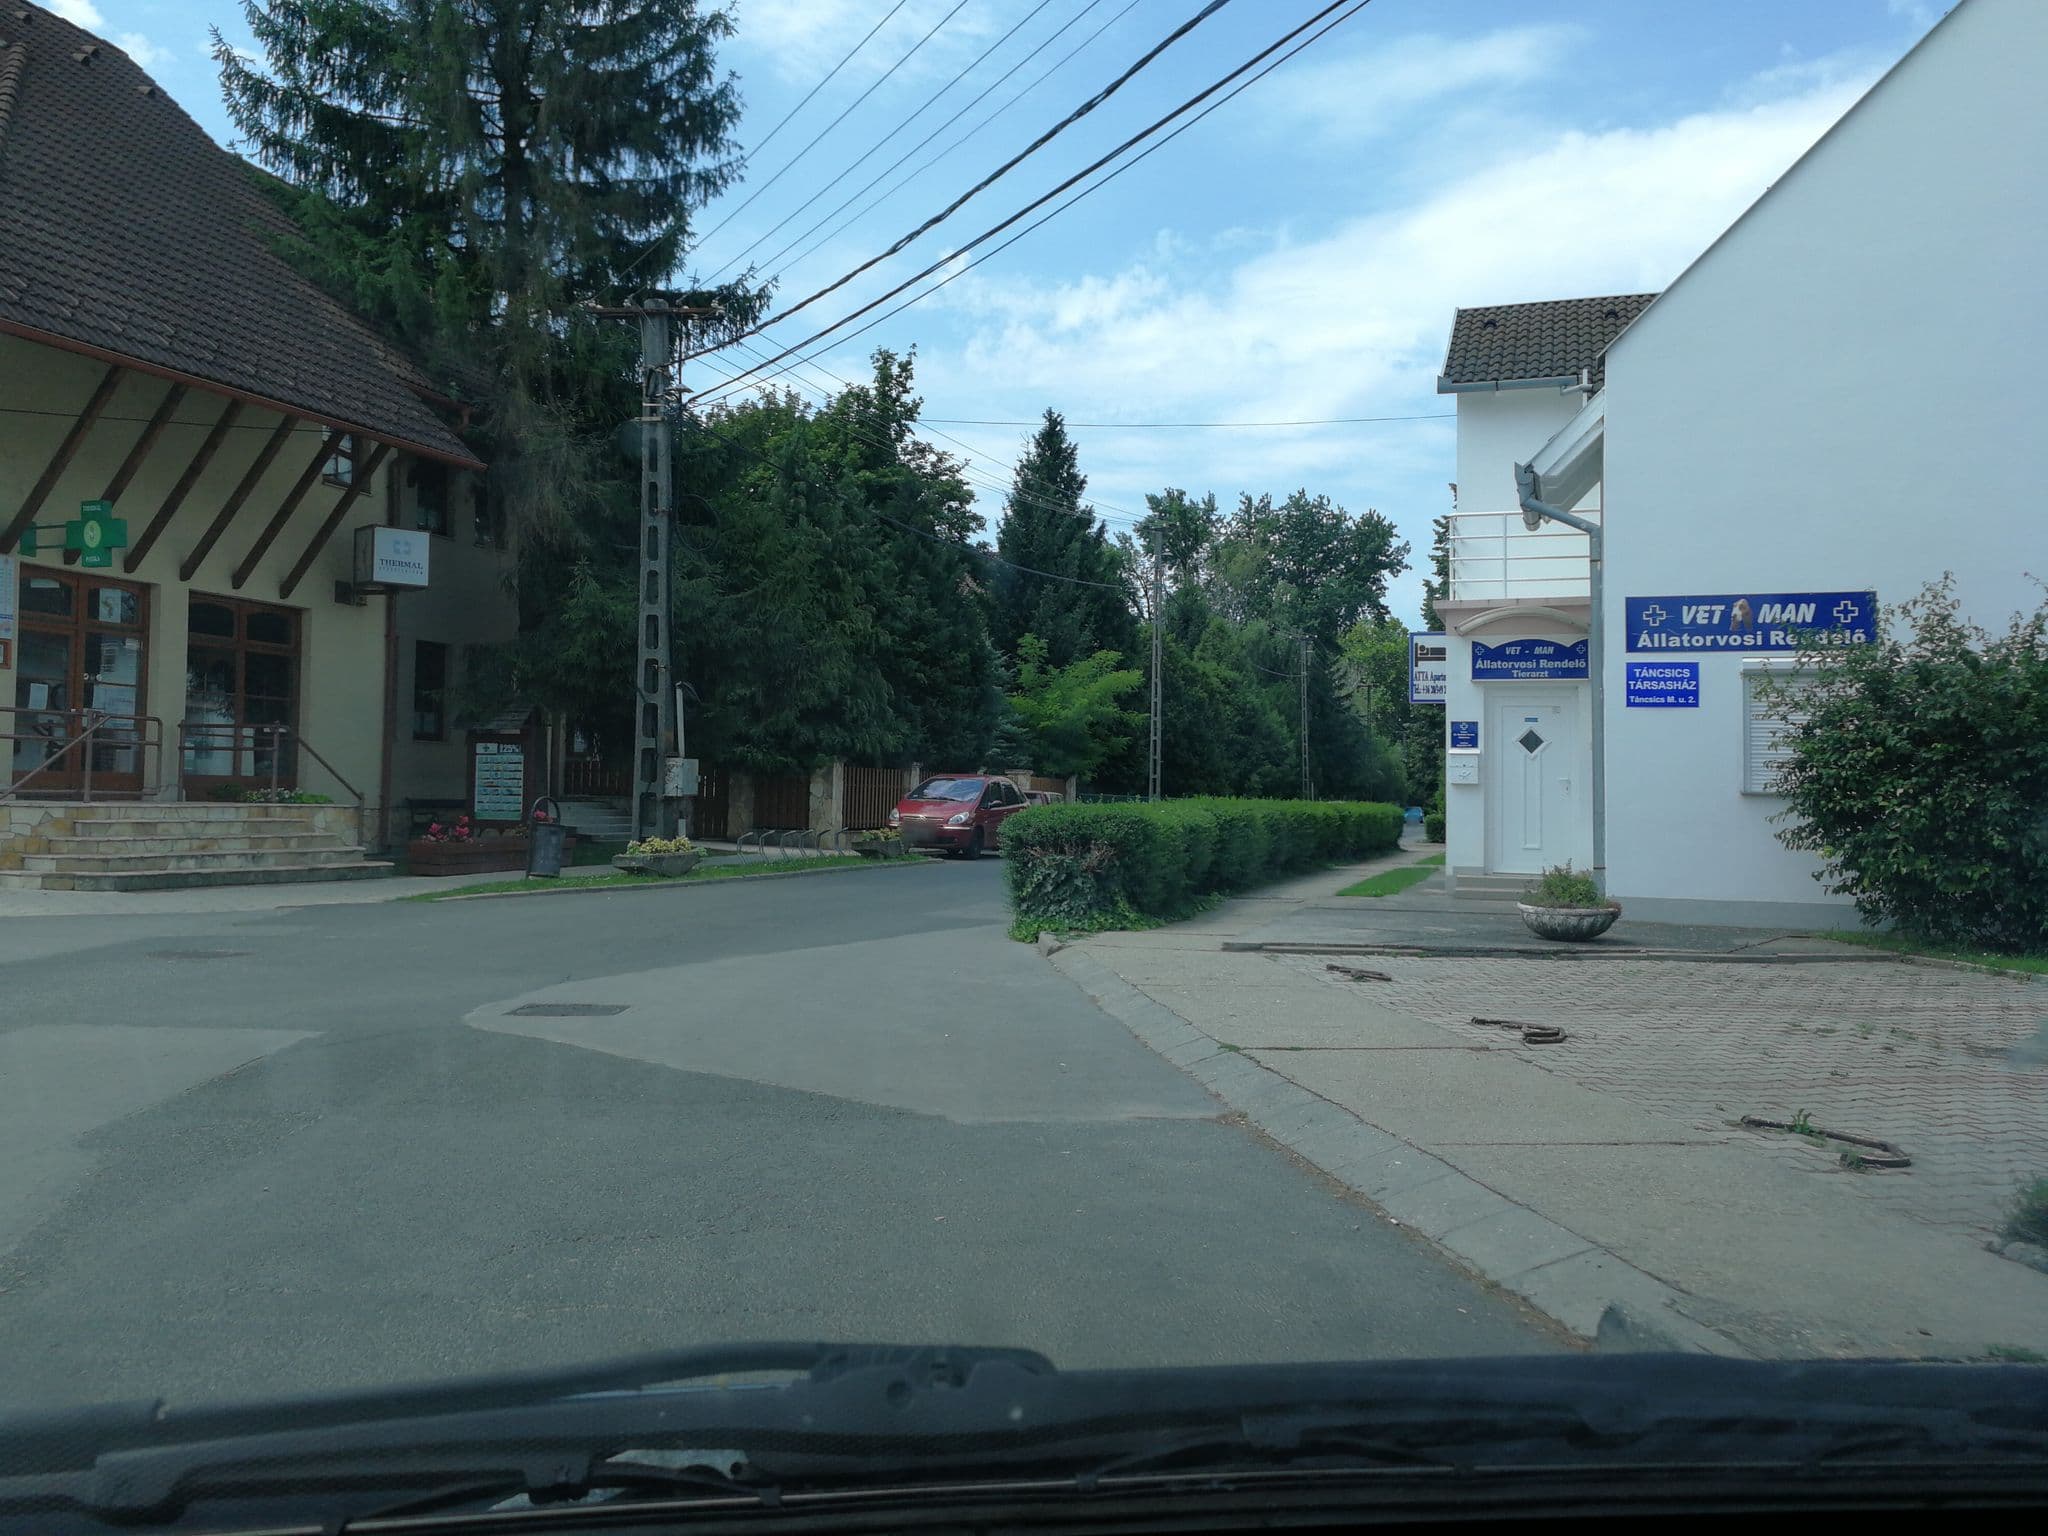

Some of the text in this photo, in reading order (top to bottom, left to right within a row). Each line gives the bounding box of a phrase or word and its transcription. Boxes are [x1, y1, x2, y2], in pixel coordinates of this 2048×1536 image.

[379, 558, 424, 570] THERMAL
[1682, 603, 1816, 624] VET MAN
[1638, 629, 1867, 648] Állatorvosi Redelő
[1505, 646, 1521, 656] VET
[1533, 646, 1554, 656] MAN
[1475, 658, 1586, 669] Állatorvosi Rendelő
[1634, 667, 1690, 678] TÁNCSICS
[1628, 679, 1697, 690] TÁRSASHÁZ
[1628, 695, 1665, 703] Táncsics
